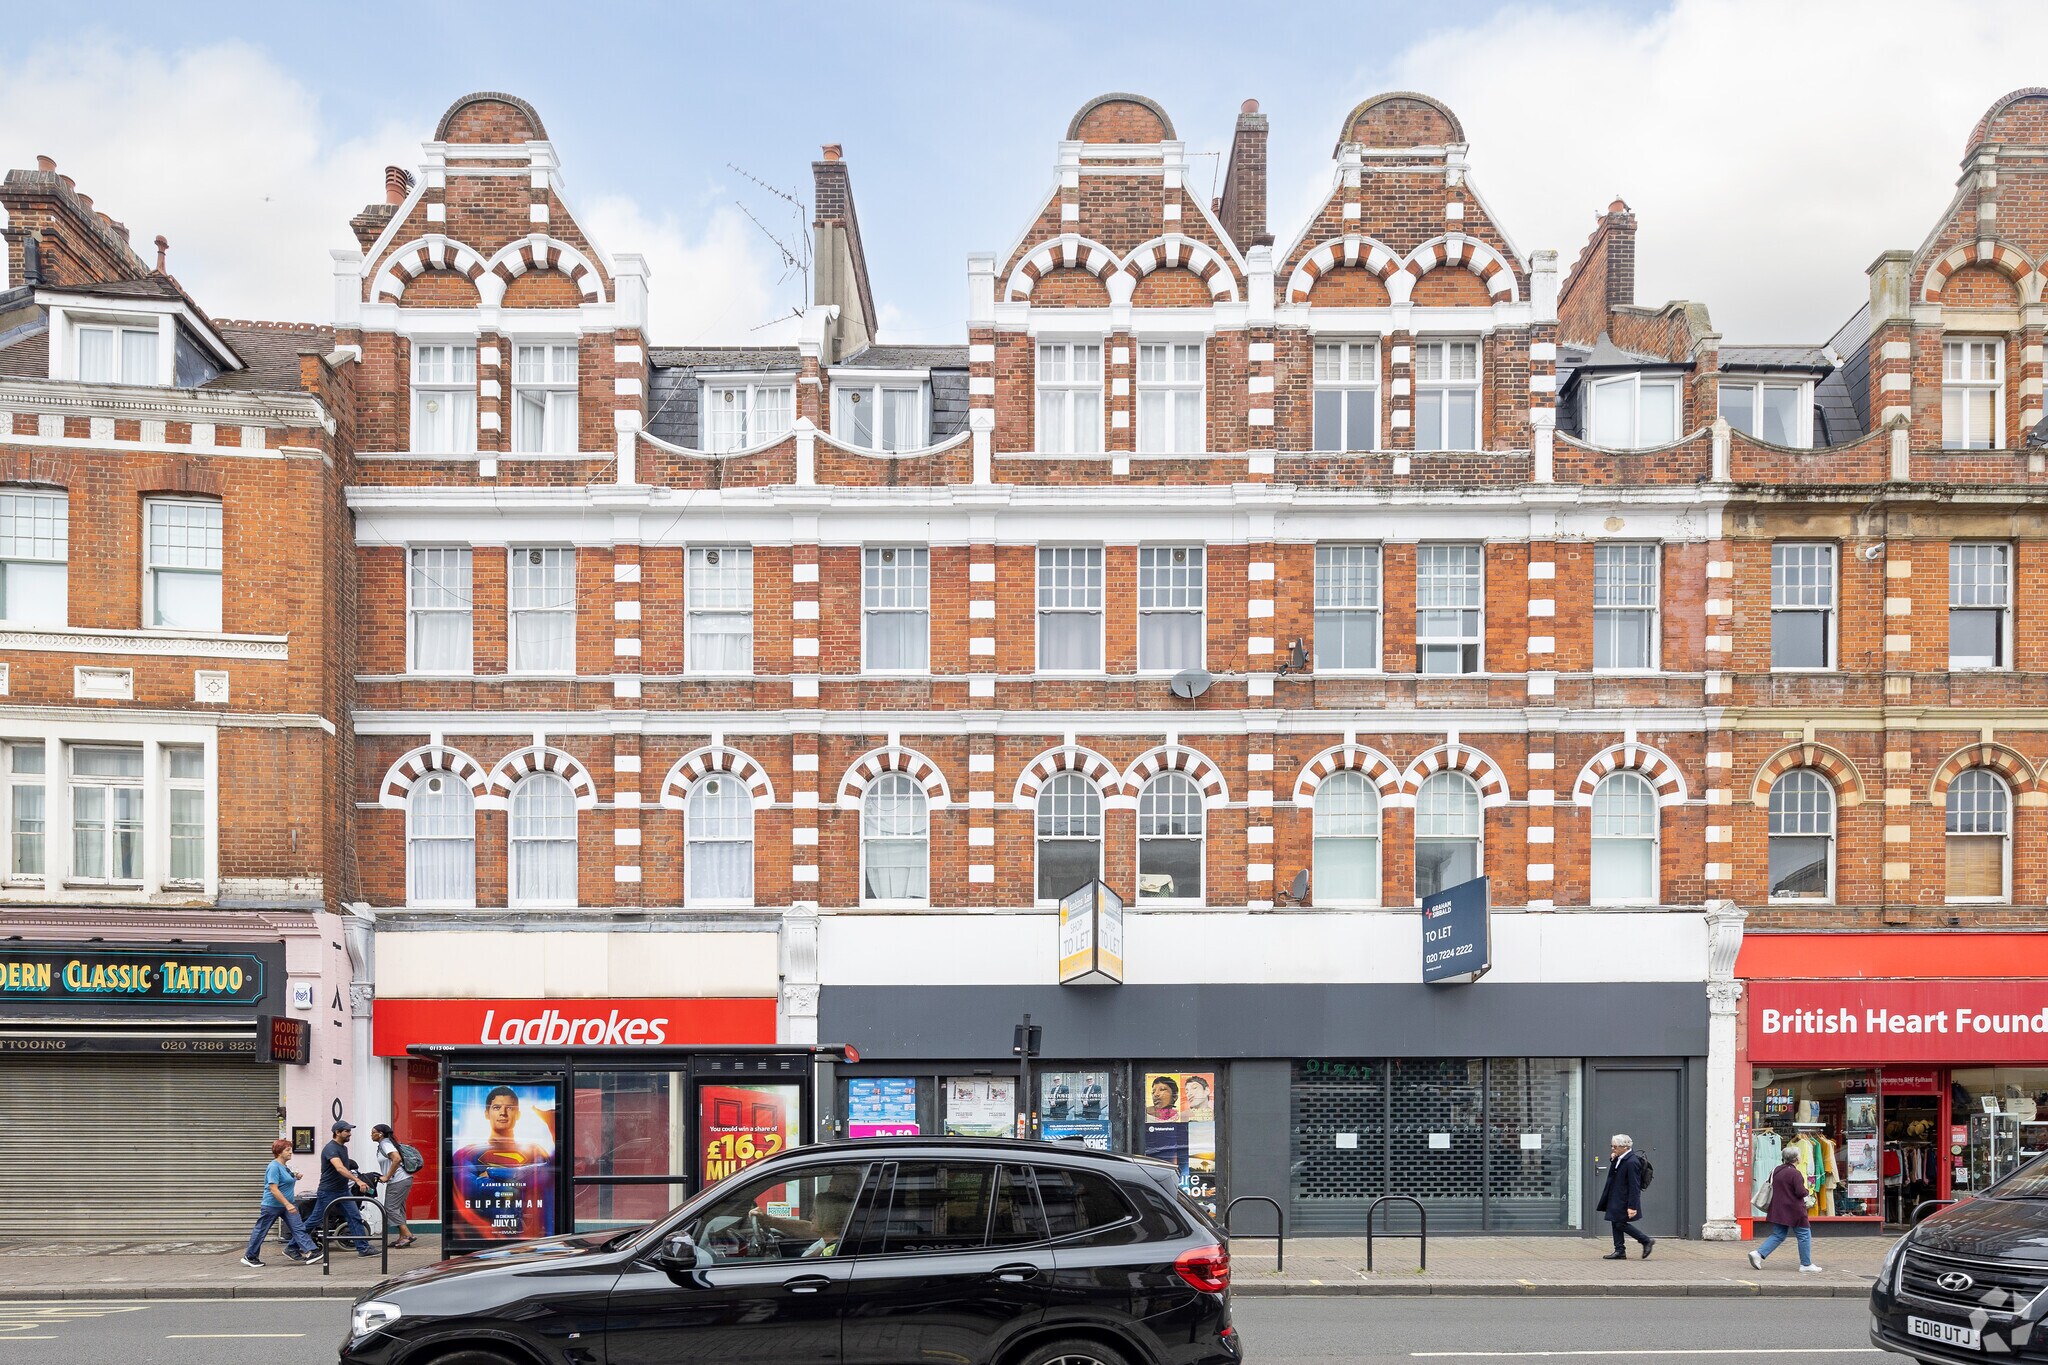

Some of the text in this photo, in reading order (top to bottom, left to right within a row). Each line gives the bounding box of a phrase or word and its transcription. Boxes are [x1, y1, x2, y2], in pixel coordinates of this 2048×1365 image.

[1432, 900, 1452, 912] GRAHAM
[1064, 930, 1090, 956] TO LET
[1426, 925, 1452, 943] TO LET
[1110, 934, 1120, 955] LET
[1426, 944, 1472, 964] 020 7224 2222
[65, 960, 152, 990] CLASSIC
[162, 961, 243, 991] TATTOO
[274, 1021, 304, 1034] MODERN
[480, 1009, 668, 1045] Ladbrokes
[1762, 1008, 1858, 1034] British
[1866, 1008, 1948, 1034] Heart
[161, 1040, 186, 1050] 020
[192, 1041, 224, 1050] 7386
[274, 1034, 303, 1047] CLASSIC
[274, 1048, 303, 1060] TATTOO
[707, 1133, 783, 1159] £16.2
[465, 1200, 543, 1209] SUPERMAN
[492, 1219, 517, 1227] JULY 11
[1945, 1326, 1970, 1345] UTJ
